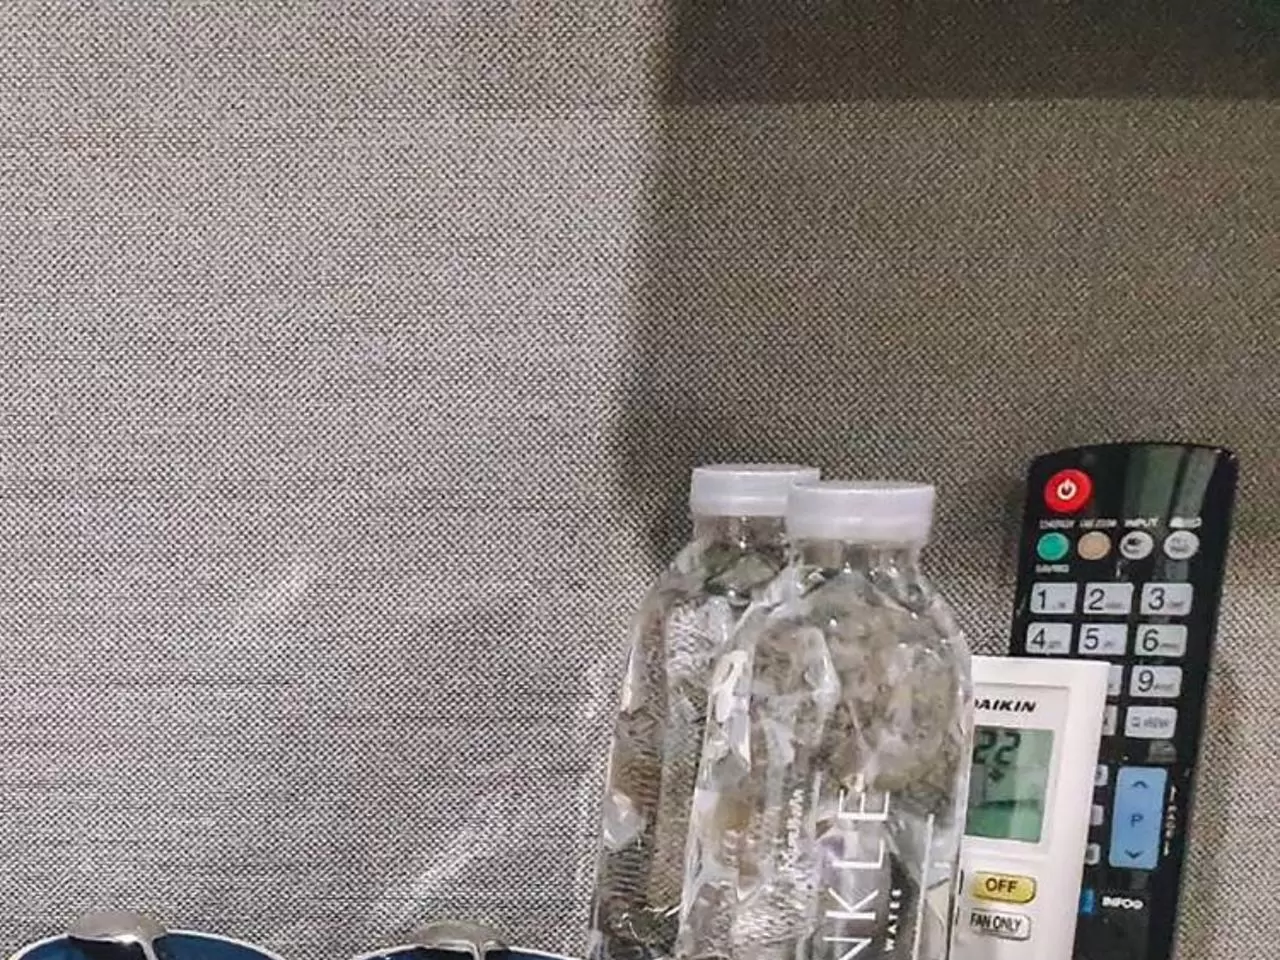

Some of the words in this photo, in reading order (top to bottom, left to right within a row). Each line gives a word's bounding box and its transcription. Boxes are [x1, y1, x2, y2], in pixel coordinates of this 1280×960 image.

[1037, 589, 1047, 610] 1
[1088, 588, 1105, 610] 2
[1147, 587, 1165, 610] 3
[1031, 627, 1046, 649] 4
[1084, 628, 1099, 650] 5
[1142, 629, 1159, 652] 6
[1137, 670, 1154, 692] 9
[1129, 812, 1144, 828] P
[985, 877, 1019, 894] OFF
[970, 912, 990, 929] FAN
[992, 915, 1022, 932] ONLY
